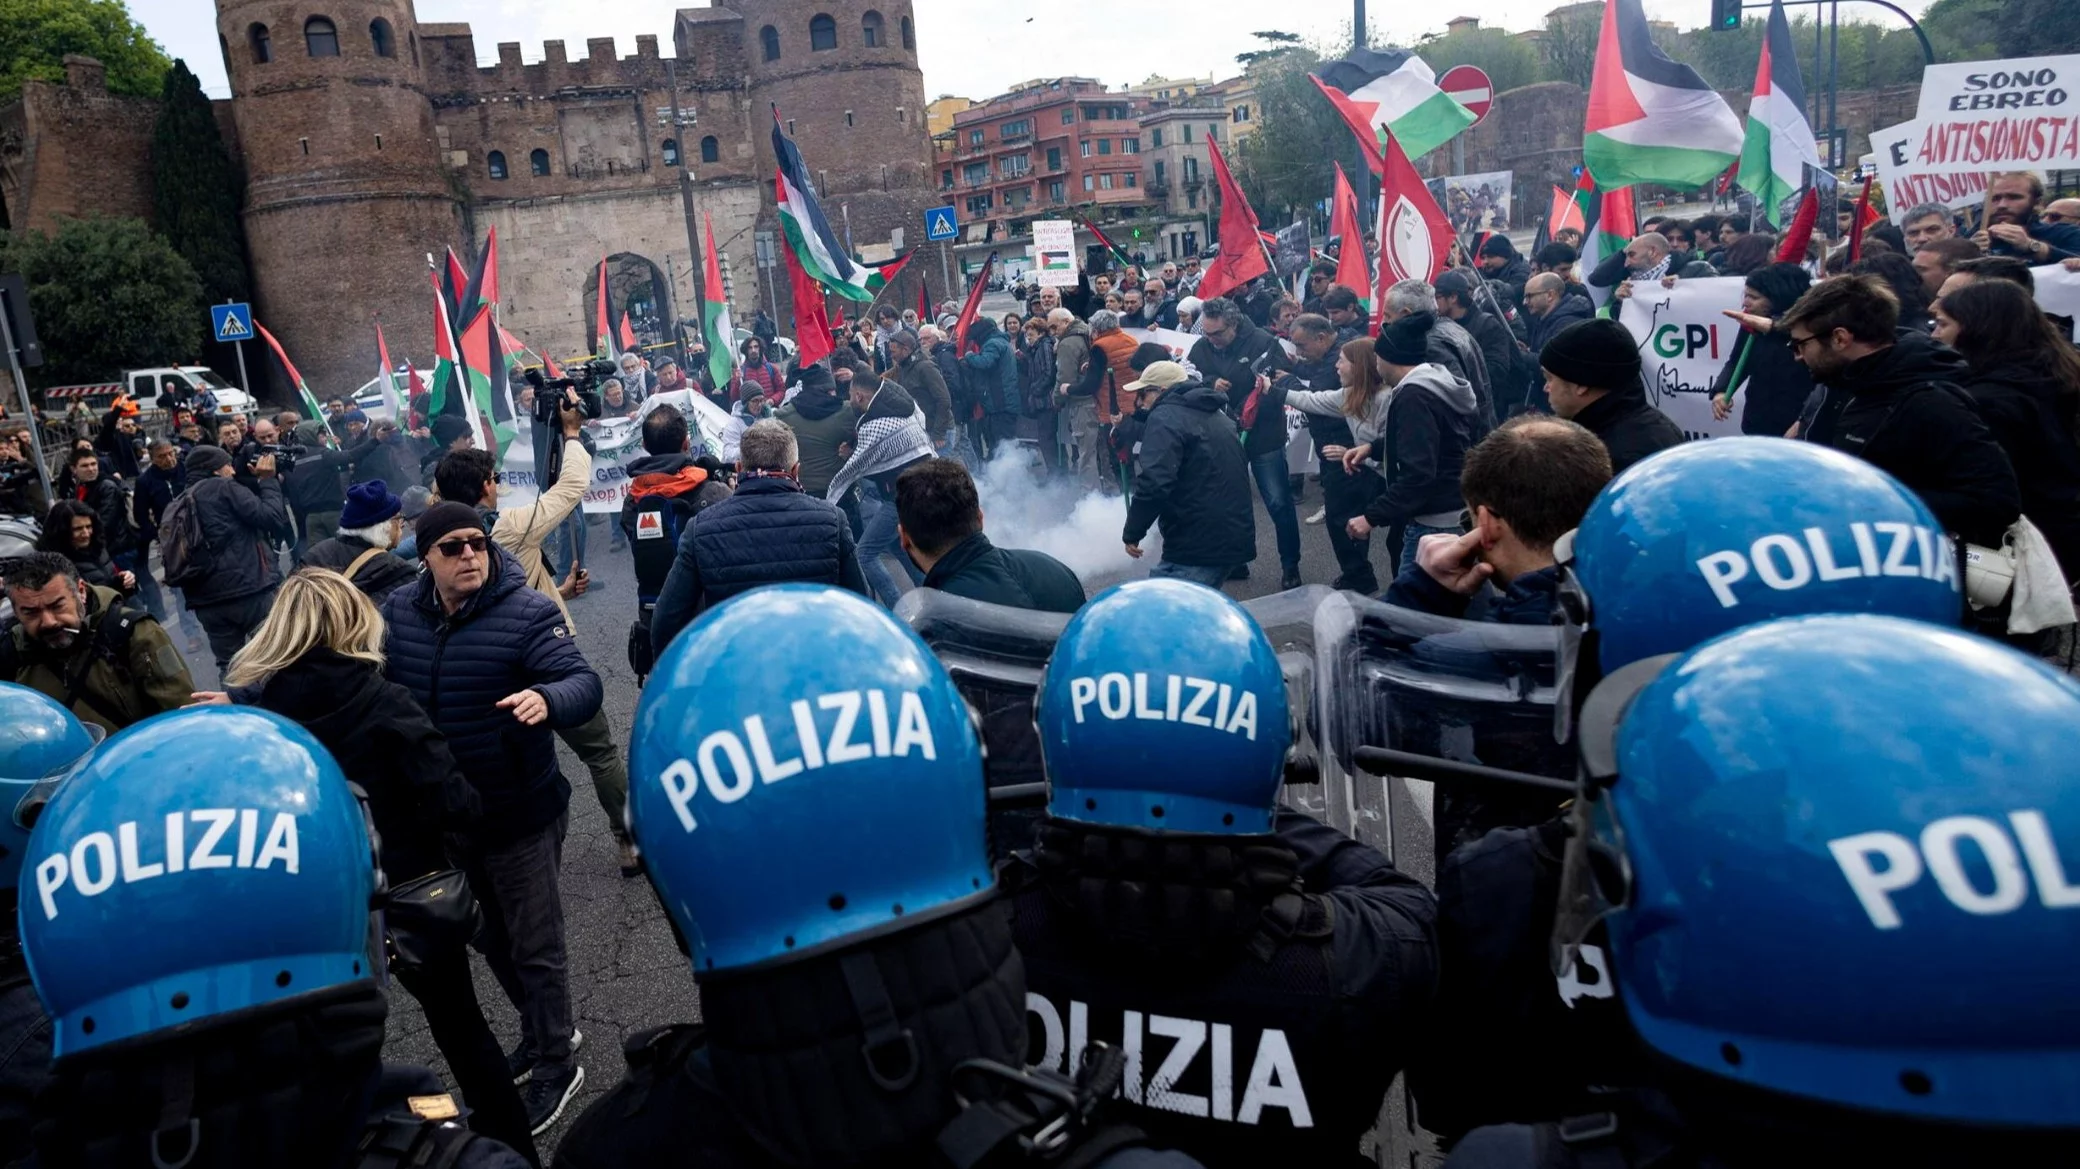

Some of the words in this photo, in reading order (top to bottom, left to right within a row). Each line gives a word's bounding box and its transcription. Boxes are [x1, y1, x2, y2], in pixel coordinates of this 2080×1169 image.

[1948, 88, 2068, 112] EBREO
[1964, 68, 2057, 92] SONO
[1916, 115, 2079, 166] ANTISIONISTA
[1653, 323, 1719, 360] GPI
[1696, 522, 1960, 609] POLIZIA
[1071, 672, 1258, 742] POLIZIA
[659, 688, 937, 834] POLIZIA
[36, 808, 300, 920] POLIZIA
